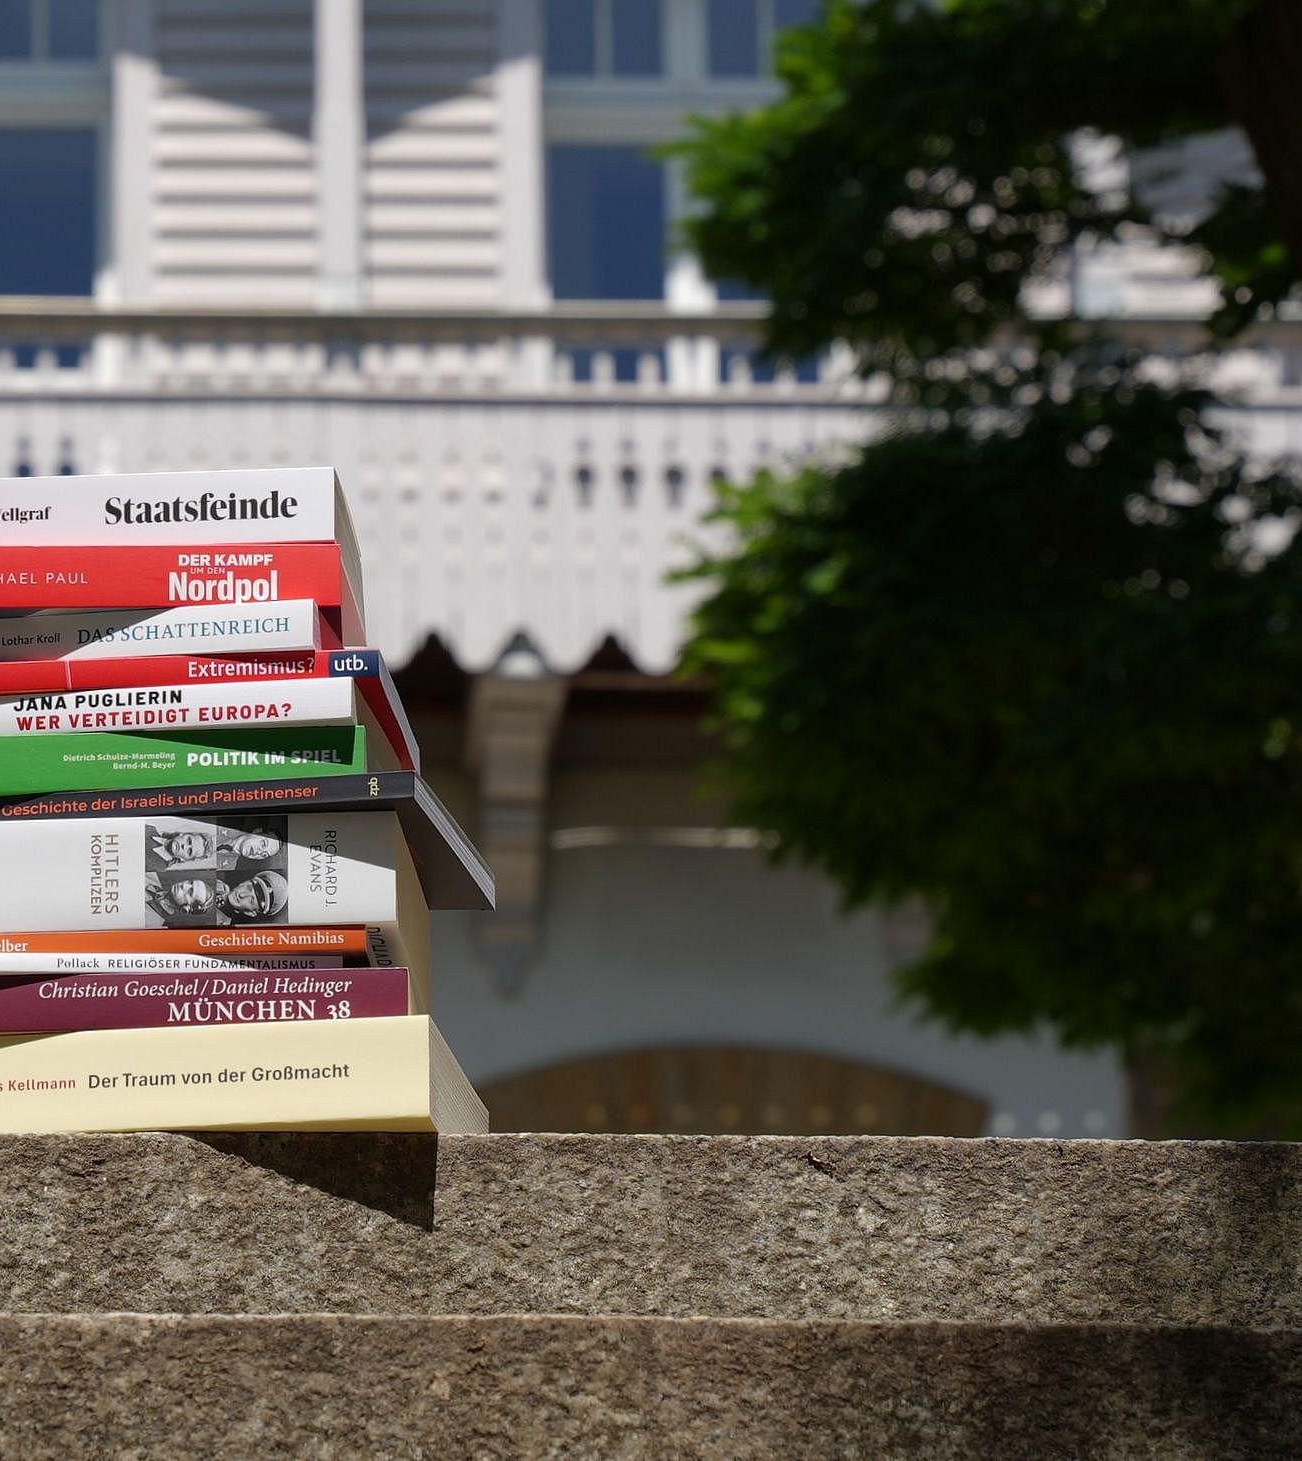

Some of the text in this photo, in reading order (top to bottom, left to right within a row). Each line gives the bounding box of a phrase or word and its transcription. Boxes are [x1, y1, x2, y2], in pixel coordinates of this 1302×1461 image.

[104, 489, 299, 525] Staatsfeinde
[178, 553, 274, 567] DER KAMPF
[189, 566, 226, 574] UM DEN
[45, 572, 89, 585] PAUL
[168, 569, 278, 604] Nordpol
[36, 632, 61, 645] Kroll
[77, 617, 290, 645] DAS SCHATTENREICH
[187, 657, 315, 678] Extremismus?
[333, 655, 369, 672] utb.
[13, 689, 183, 713] JANA PUGLIERIN
[16, 702, 292, 732] WER VERTEIDIGT EUROPA?
[62, 751, 176, 762] Dietrich Schulze-Marmeling
[112, 761, 176, 770] Bernd-M. Beyer
[186, 750, 342, 767] POLITIK IM SPIEL
[1, 799, 88, 818] Geschichte
[90, 797, 117, 813] der
[121, 794, 174, 809] Israelis
[177, 790, 209, 806] und
[212, 787, 318, 804] Palästinenser
[90, 834, 102, 915] KOMPLIZEN
[105, 833, 119, 914] HITLERS
[309, 845, 322, 893] EVANS
[323, 829, 338, 909] RICHARD J.
[198, 931, 344, 948] Geschichte Namibias
[56, 955, 316, 970] Pollack RELIGIÖSER FUNDAMENTALISMUS
[38, 980, 118, 1000] Christian
[273, 977, 353, 998] Hedinger
[167, 997, 351, 1023] MÜNCHEN 38
[8, 1077, 76, 1092] Kellmann
[88, 1073, 119, 1089] Der
[122, 1071, 176, 1087] Traum
[181, 1072, 212, 1085] von
[217, 1068, 246, 1083] der
[251, 1063, 350, 1082] Großmacht
